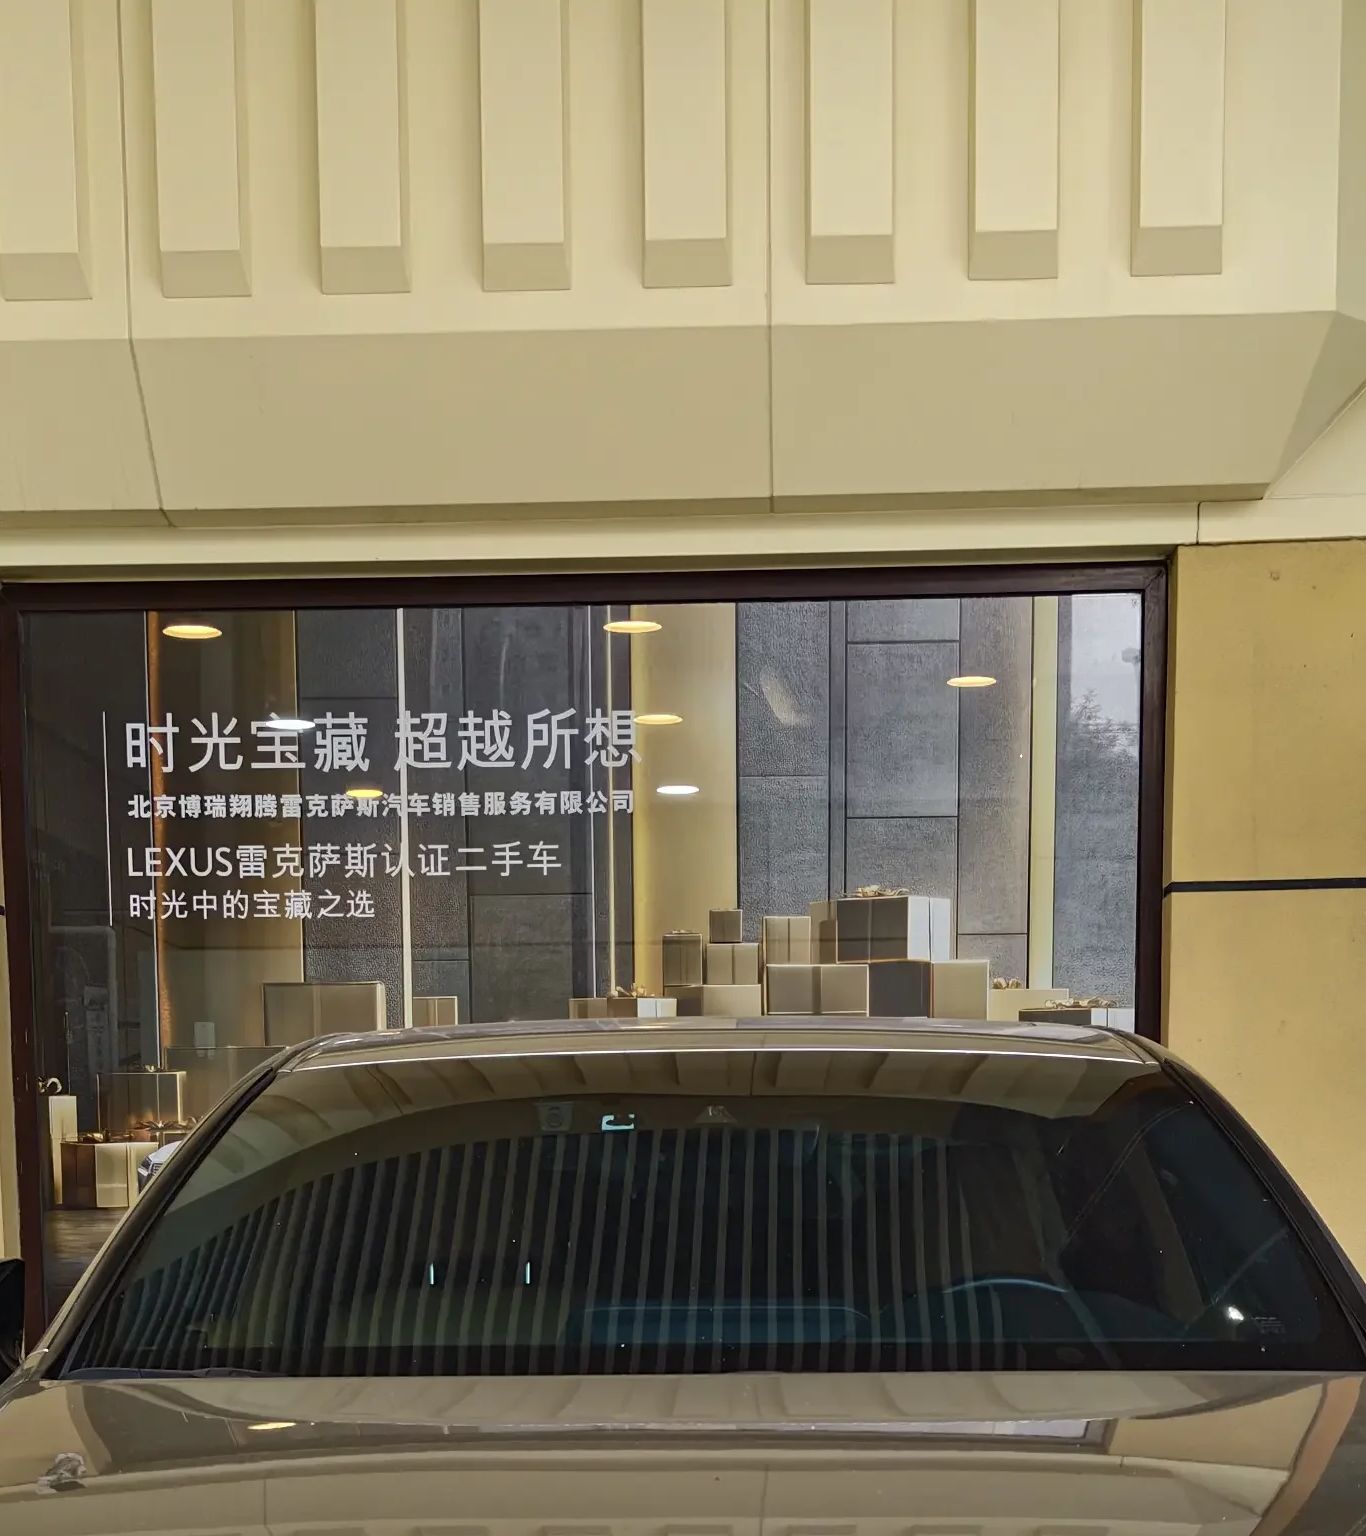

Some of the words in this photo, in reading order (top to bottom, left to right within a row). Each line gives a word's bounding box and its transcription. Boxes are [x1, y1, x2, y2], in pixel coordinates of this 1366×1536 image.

[126, 711, 370, 774] 时光宝藏
[394, 707, 642, 773] 超越所想
[128, 789, 634, 819] 北京博瑞翔腾雷克萨斯汽车销售服务有限公司
[128, 840, 562, 880] LEXUS雷克萨斯认证二手车
[129, 888, 375, 921] 时光中的宝藏之选
